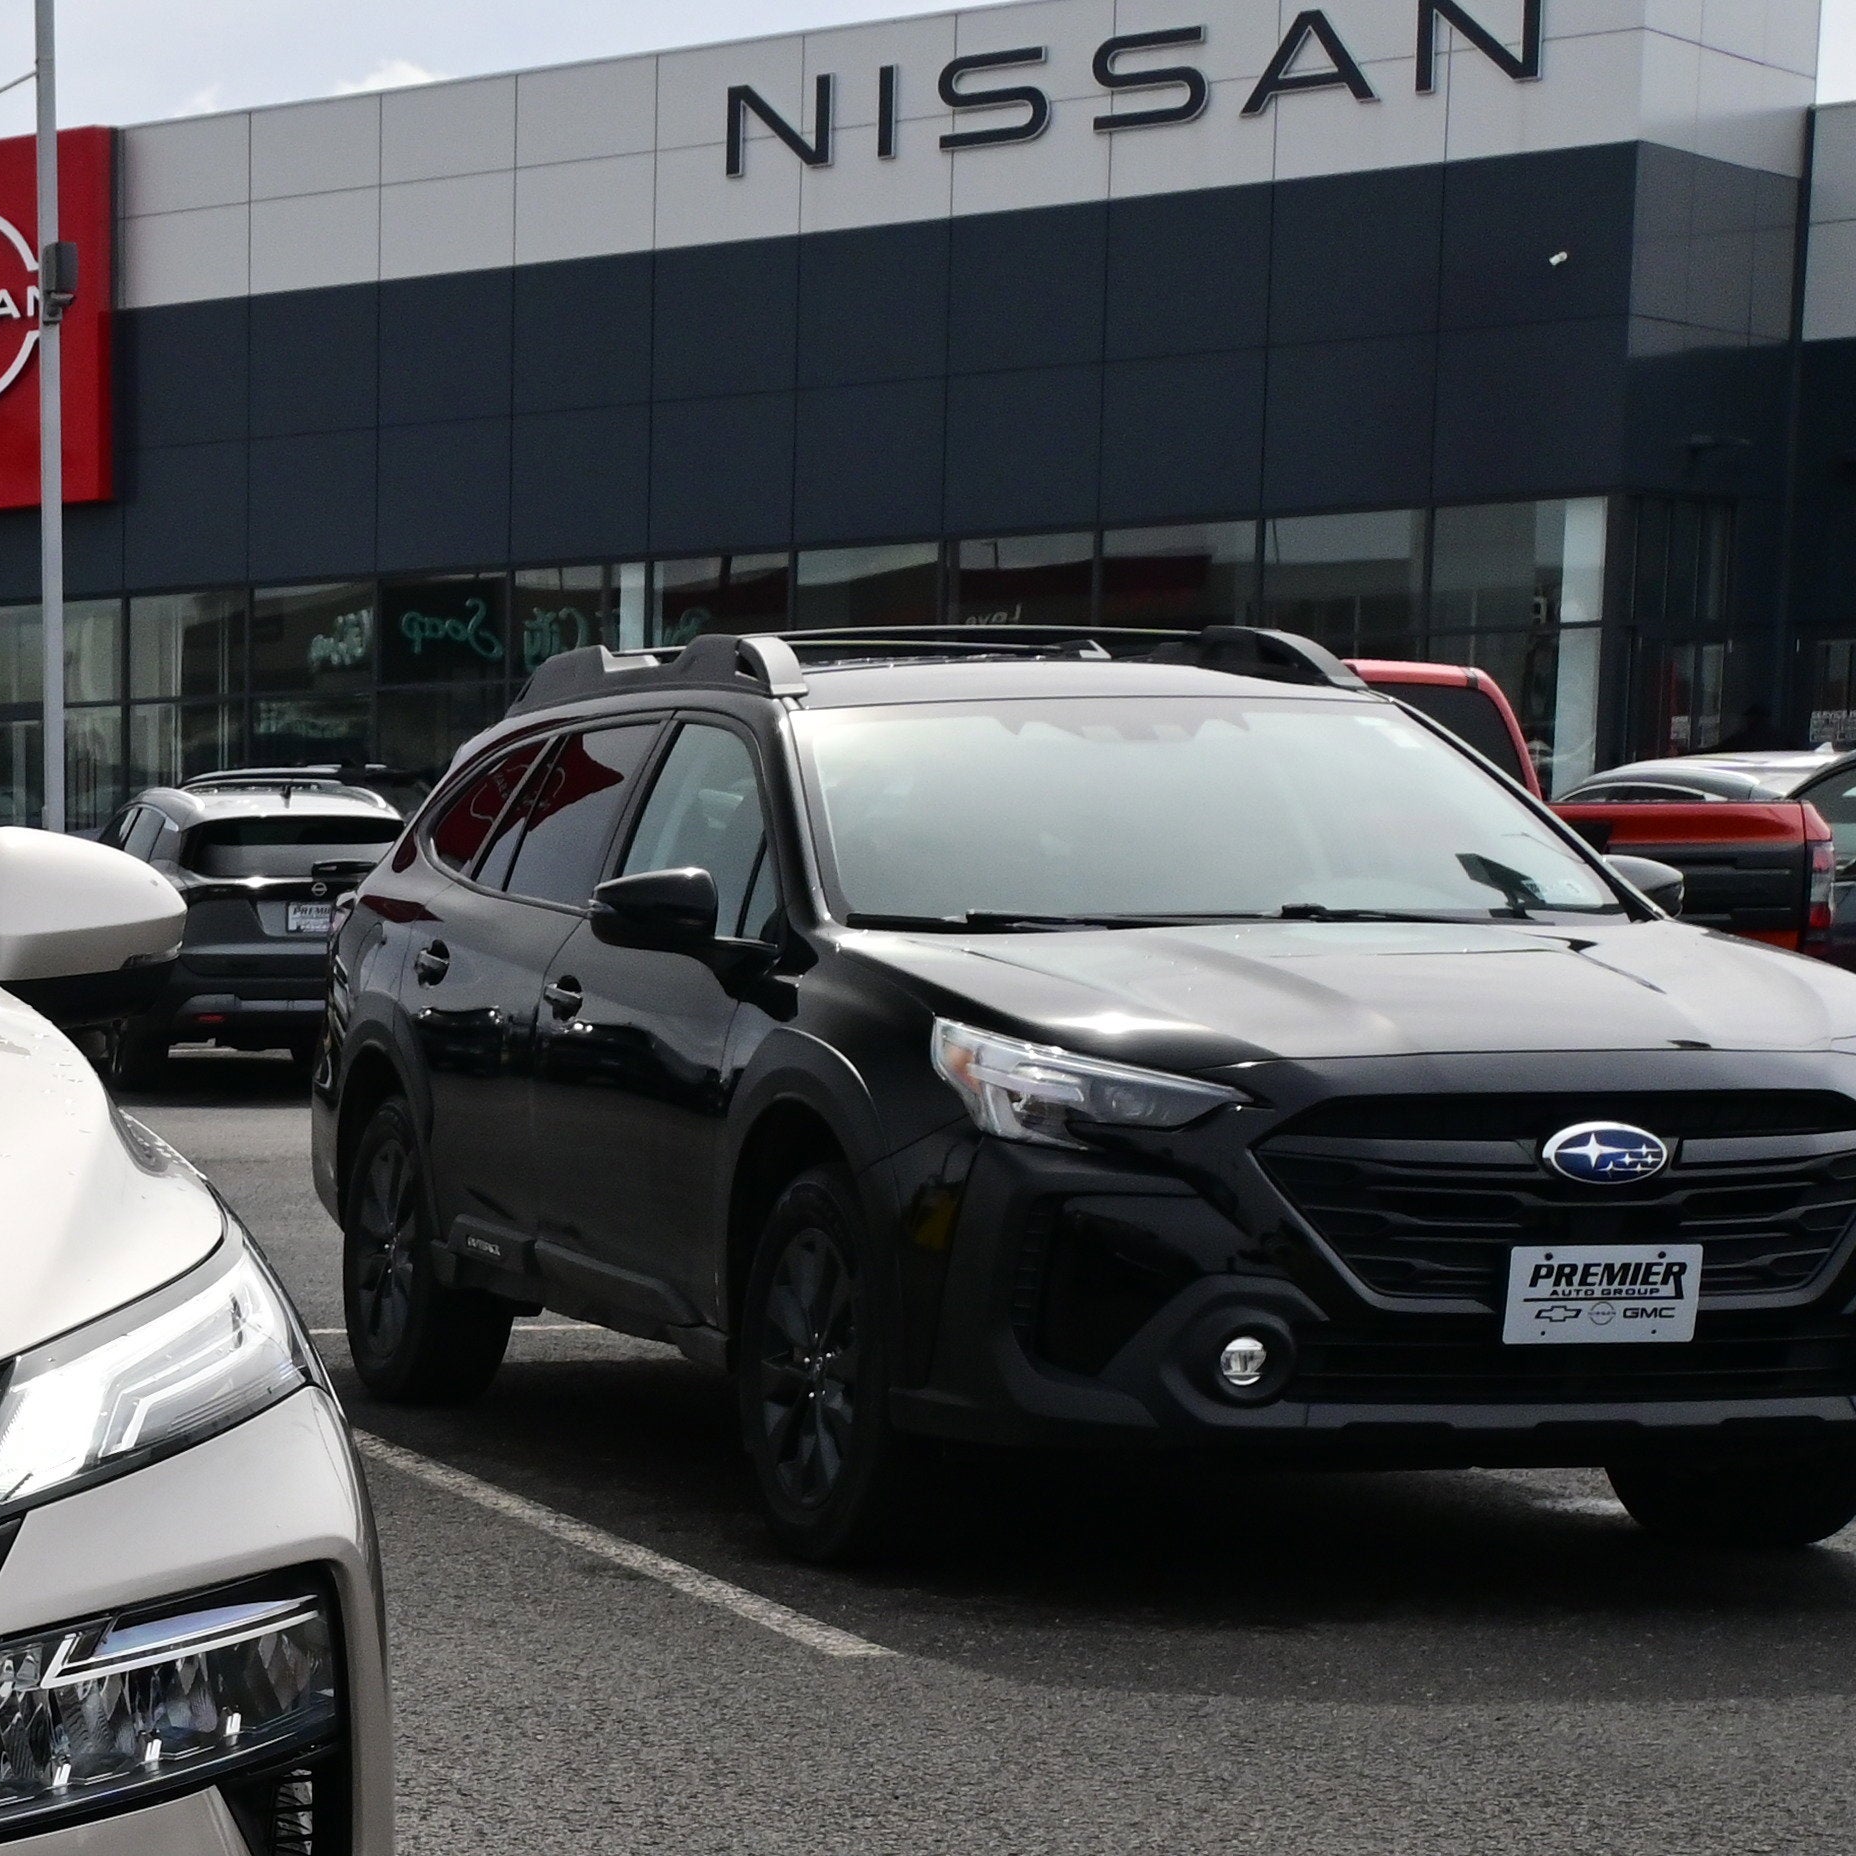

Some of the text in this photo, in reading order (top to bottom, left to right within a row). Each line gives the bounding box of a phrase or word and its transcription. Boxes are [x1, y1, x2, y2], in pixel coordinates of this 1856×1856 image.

[725, 0, 1542, 177] NISSAN
[1529, 1262, 1687, 1292] PREMIER
[1550, 1288, 1660, 1297] AUTO GROUP
[1623, 1307, 1676, 1319] GMC
